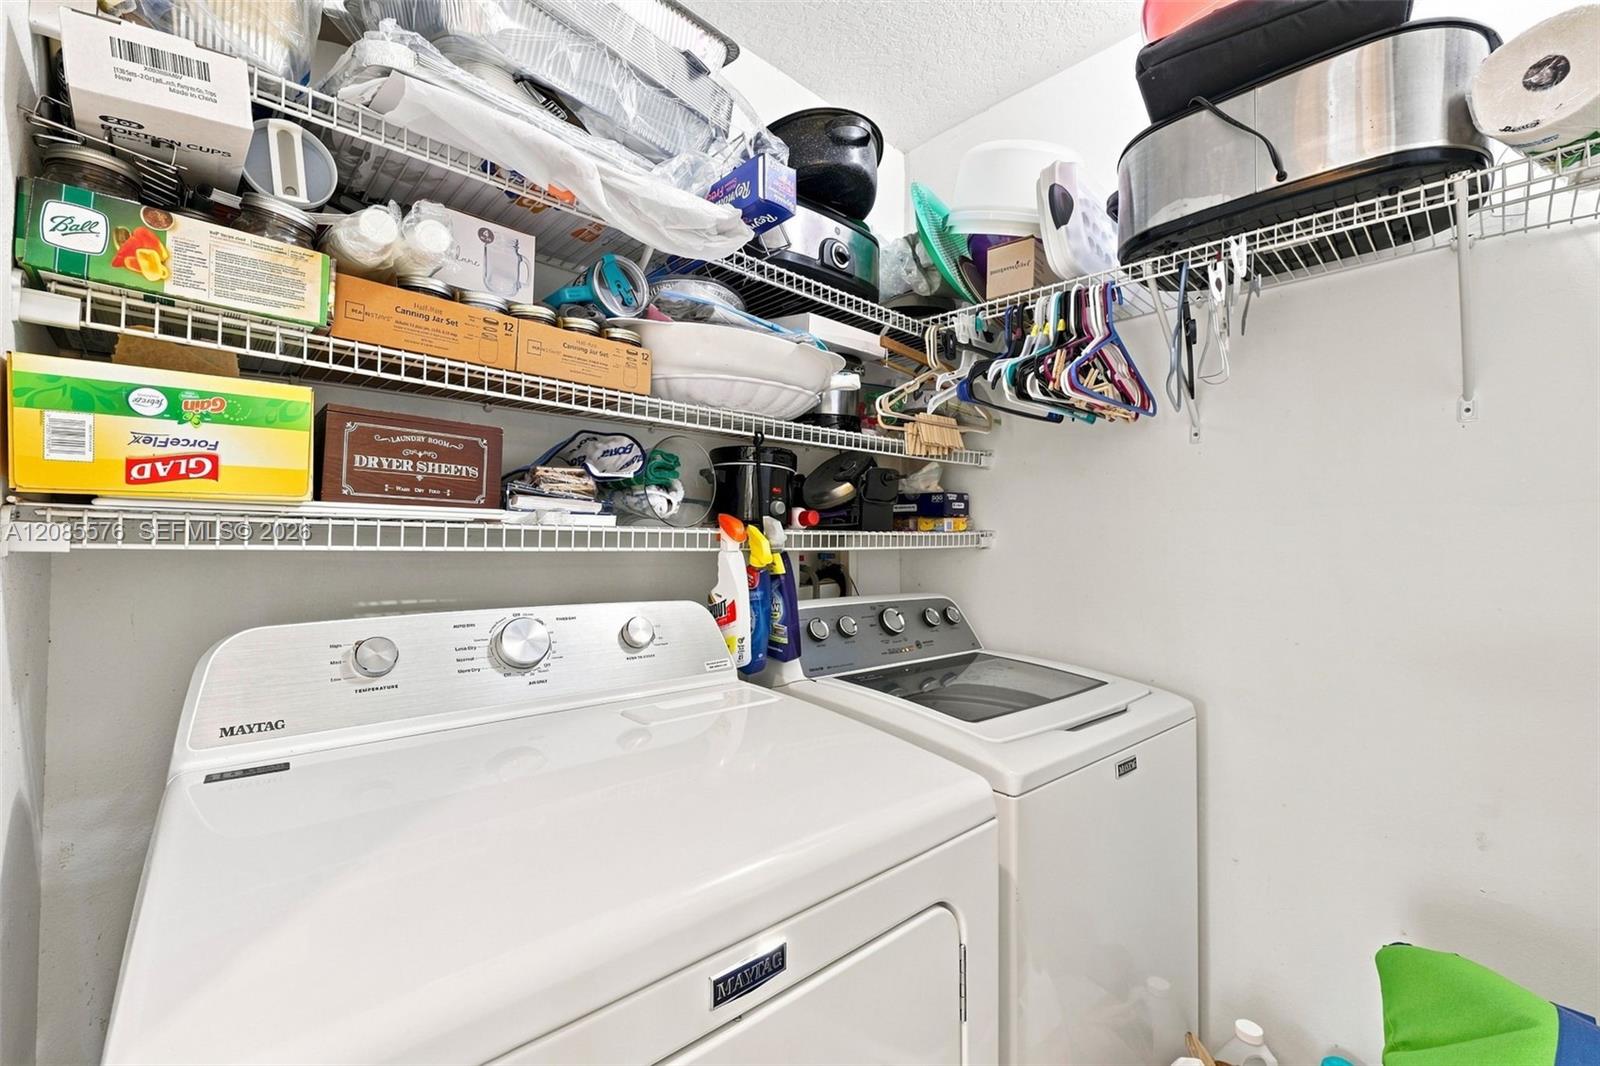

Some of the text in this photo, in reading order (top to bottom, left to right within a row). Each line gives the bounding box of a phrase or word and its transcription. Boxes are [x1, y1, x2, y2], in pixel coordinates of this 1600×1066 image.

[169, 86, 188, 97] Made
[197, 94, 217, 104] China
[186, 143, 232, 158] CUPS
[49, 215, 101, 237] Ball
[394, 305, 431, 323] Canning
[431, 313, 445, 325] Jar
[445, 316, 459, 328] Set
[503, 322, 514, 333] 12
[641, 352, 650, 362] 12
[182, 396, 226, 412] Gain
[128, 434, 219, 451] ForceFlex
[391, 434, 450, 449] LAUNDRY ROOM
[130, 456, 213, 480] GLAD
[353, 453, 480, 479] DRYER SHEETS
[354, 684, 399, 694] TEMPERATURE
[219, 719, 286, 738] MAYTAG
[716, 950, 783, 1001] MAYTAG
